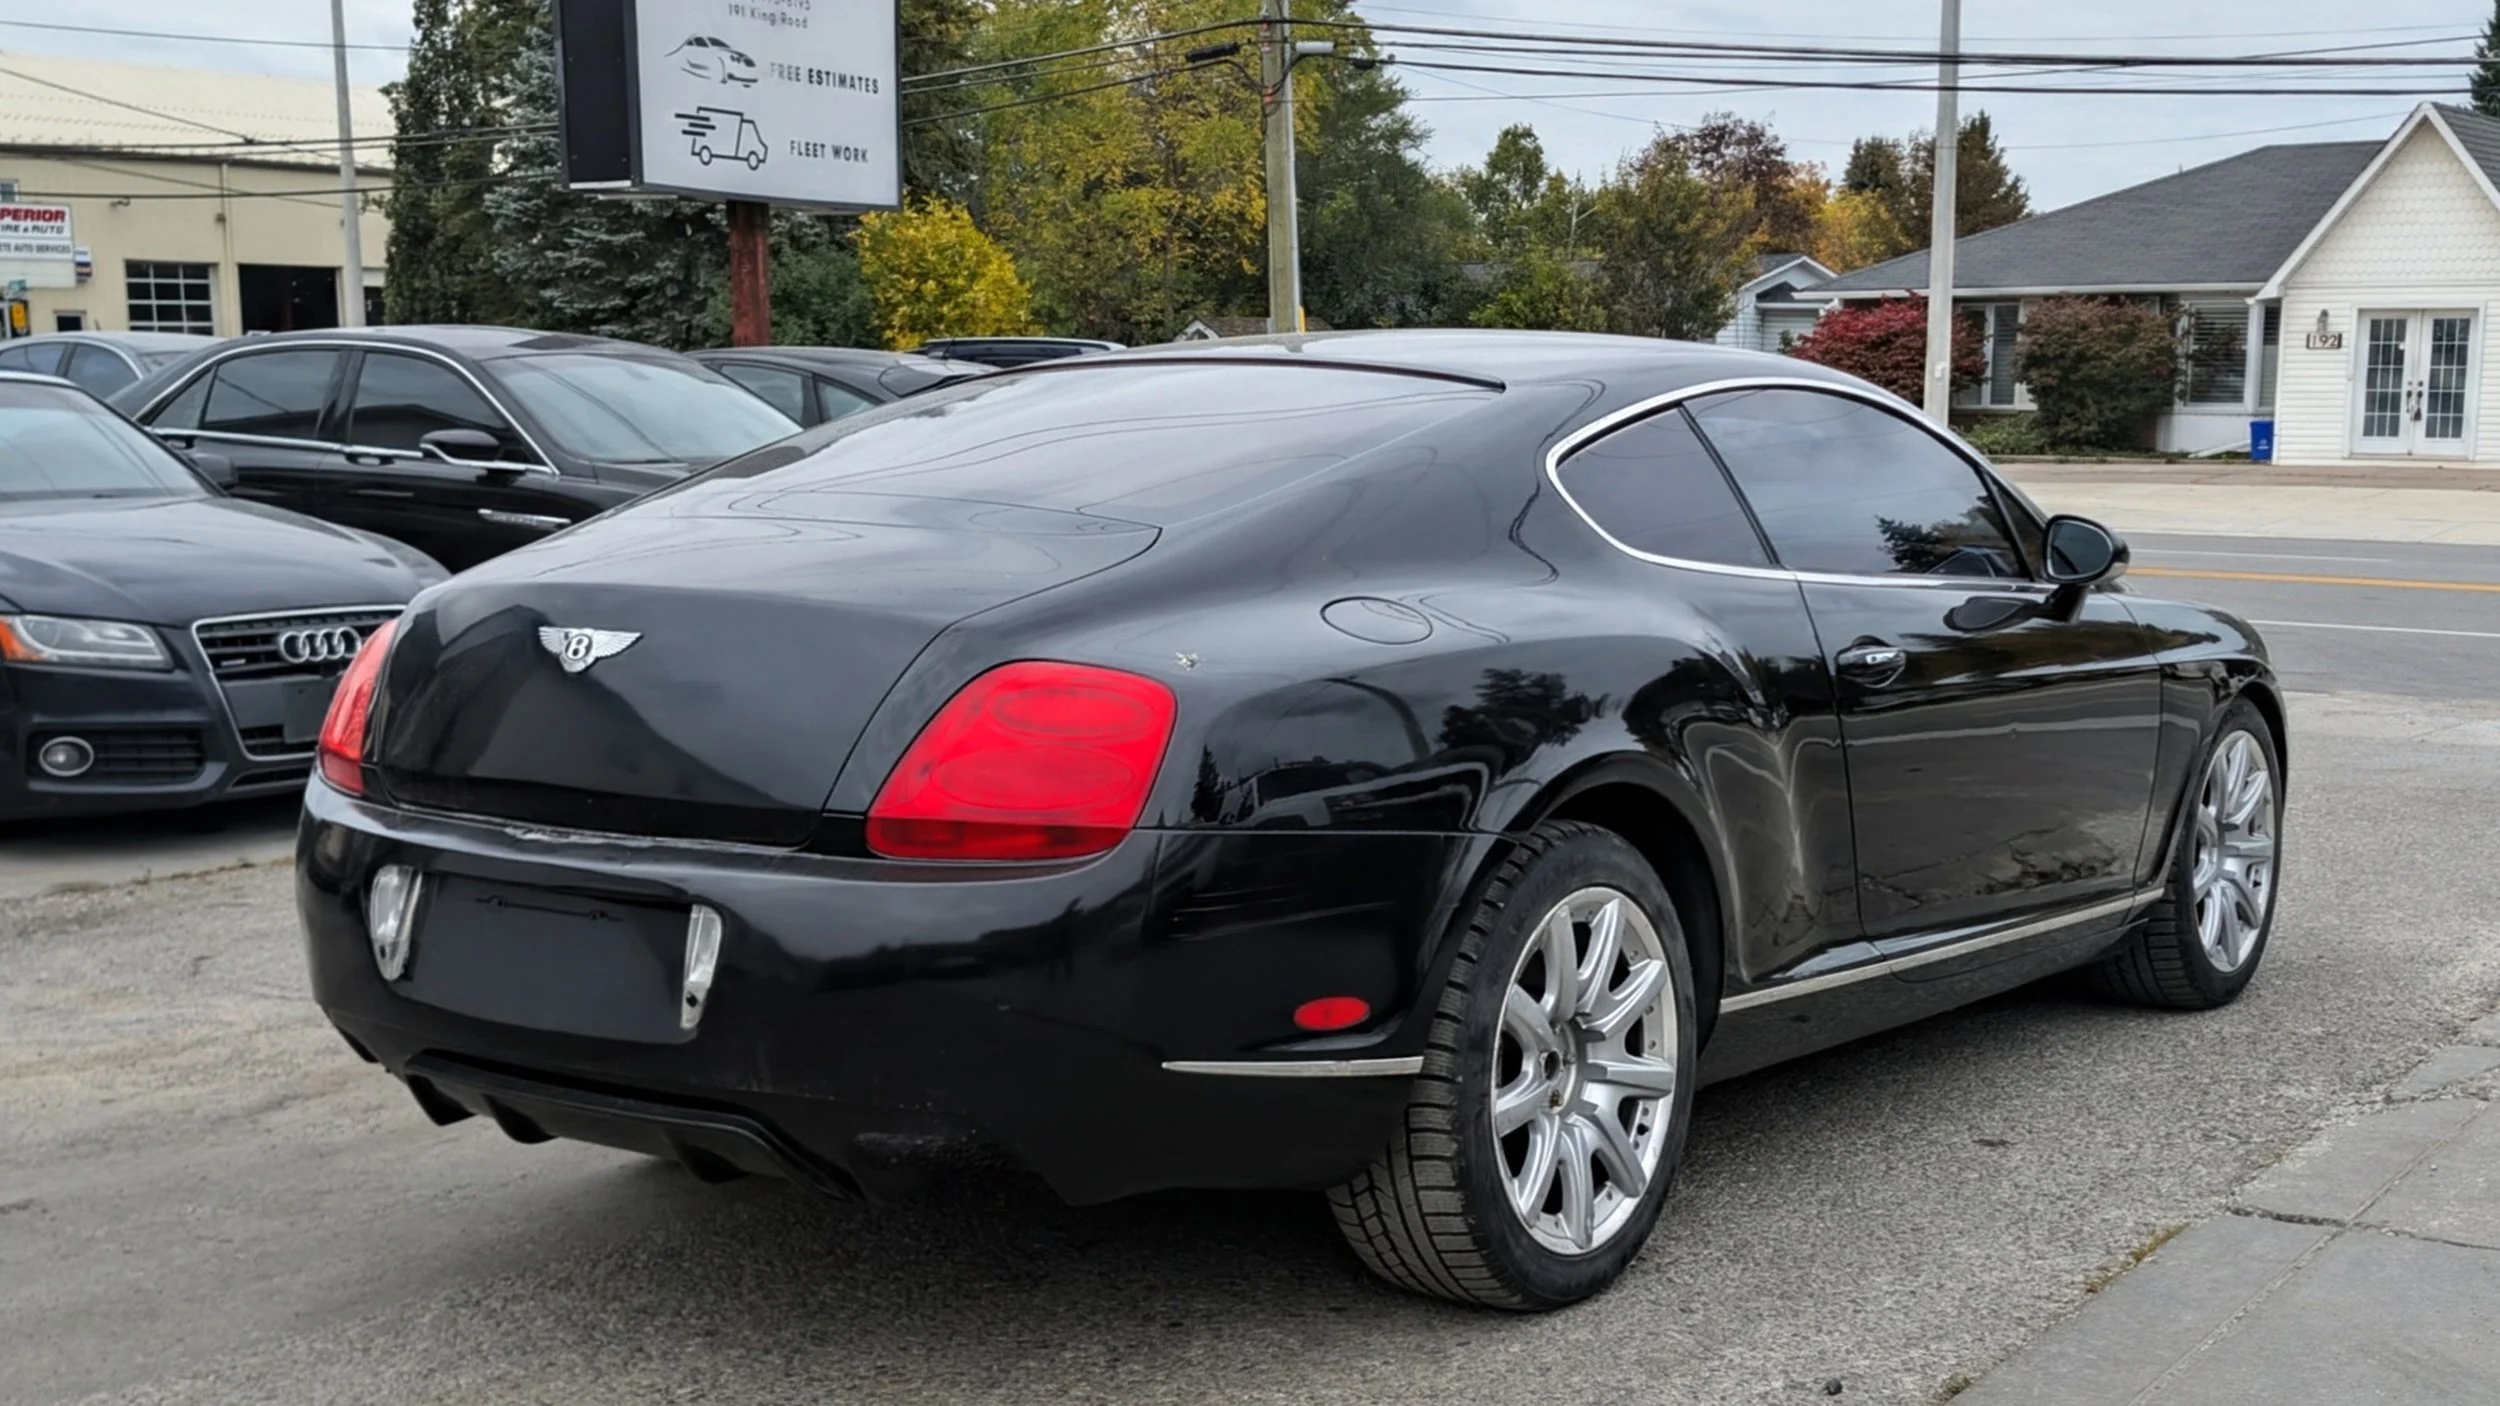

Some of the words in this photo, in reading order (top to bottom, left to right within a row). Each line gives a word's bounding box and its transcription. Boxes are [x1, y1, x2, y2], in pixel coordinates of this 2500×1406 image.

[770, 62, 801, 82] FREE
[808, 68, 879, 94] ESTIMATES
[790, 140, 826, 158] FLEET
[831, 144, 868, 163] WORK
[31, 224, 64, 234] AUTO
[2312, 334, 2338, 348] 192
